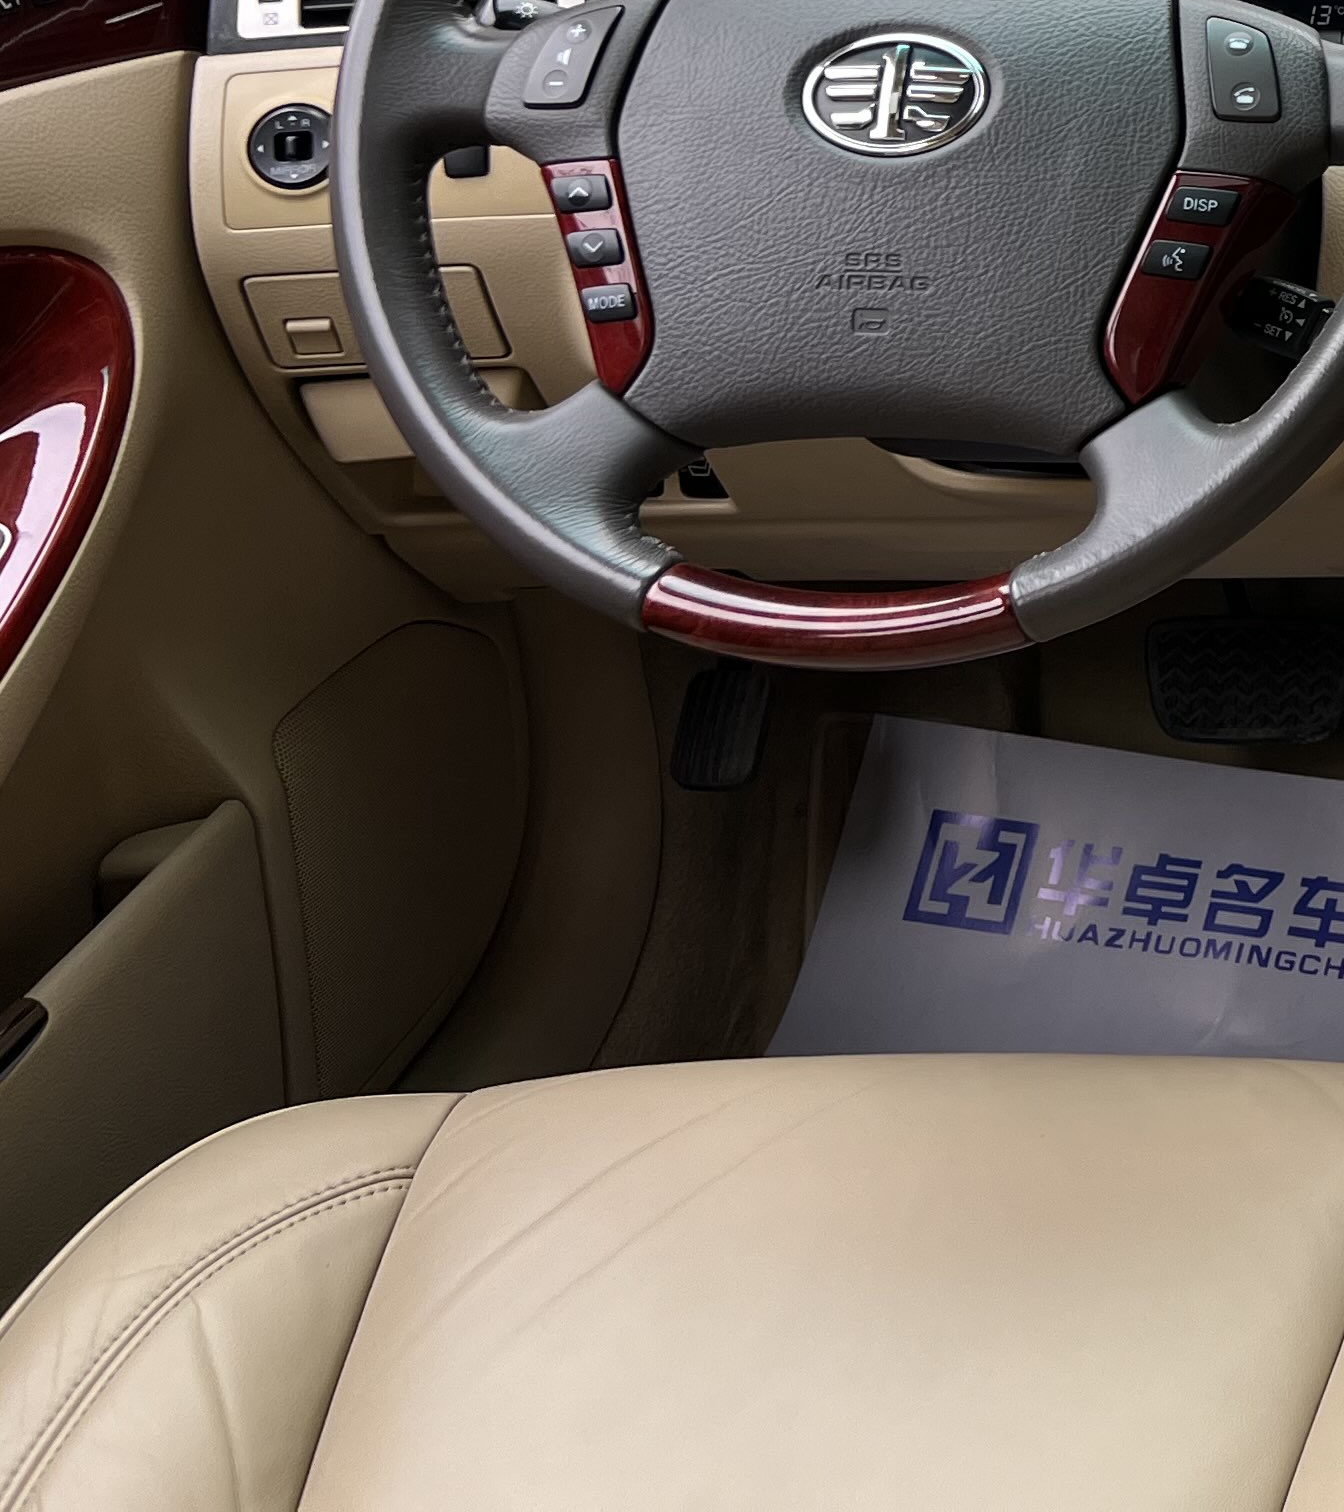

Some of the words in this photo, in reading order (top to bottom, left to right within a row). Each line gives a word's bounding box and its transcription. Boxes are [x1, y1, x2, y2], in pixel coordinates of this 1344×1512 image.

[1183, 196, 1219, 214] DISP
[845, 253, 901, 269] SRS
[815, 274, 931, 292] AIRBAG
[588, 294, 626, 310] MODE
[1279, 291, 1298, 304] RES
[1264, 323, 1282, 337] SET
